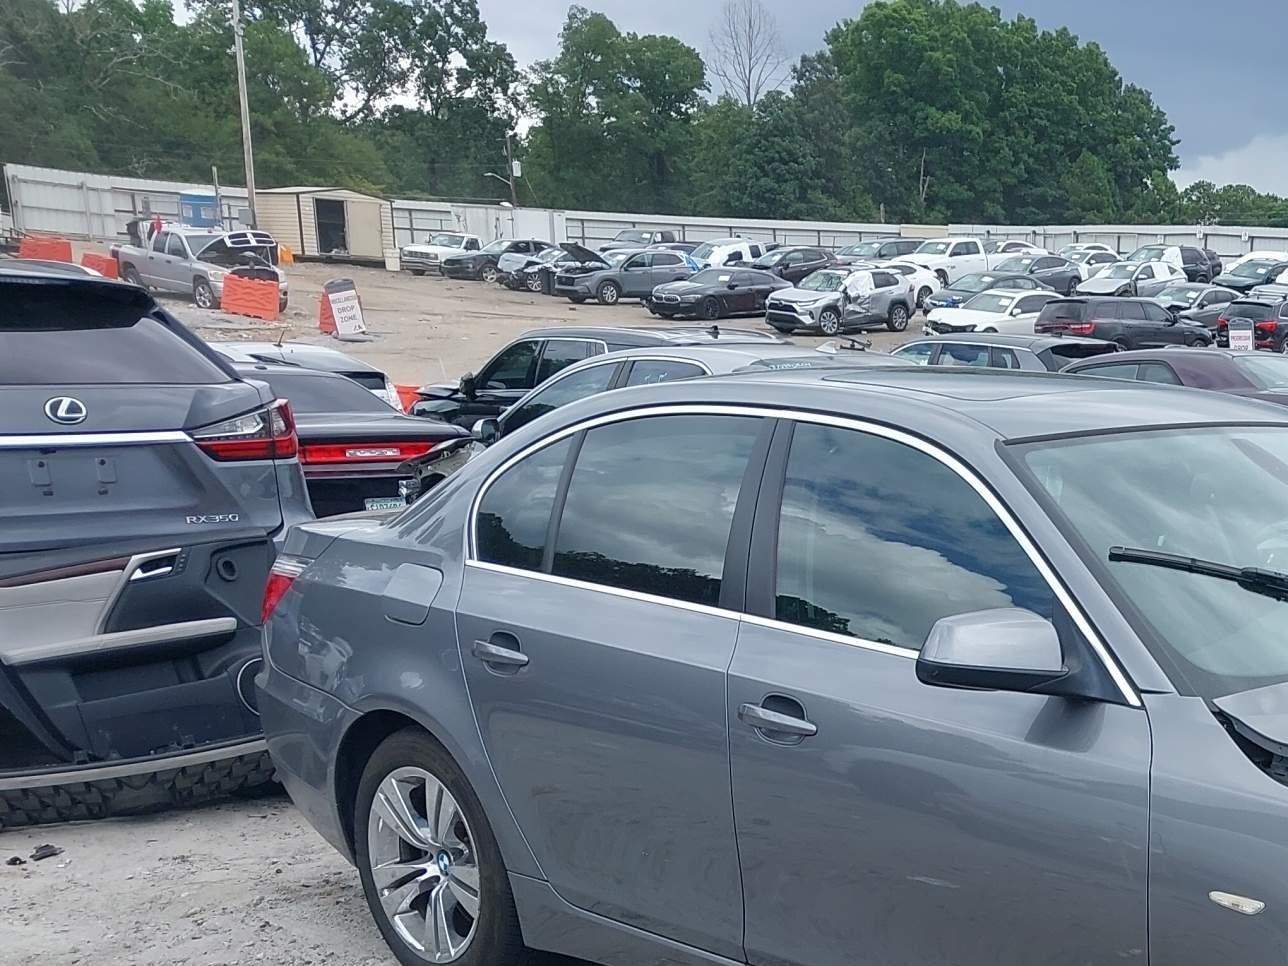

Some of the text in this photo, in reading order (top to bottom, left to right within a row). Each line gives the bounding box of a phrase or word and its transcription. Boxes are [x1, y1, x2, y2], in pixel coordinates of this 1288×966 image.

[336, 304, 355, 314] DROP
[339, 313, 358, 323] ZONE
[185, 512, 240, 525] RX350
